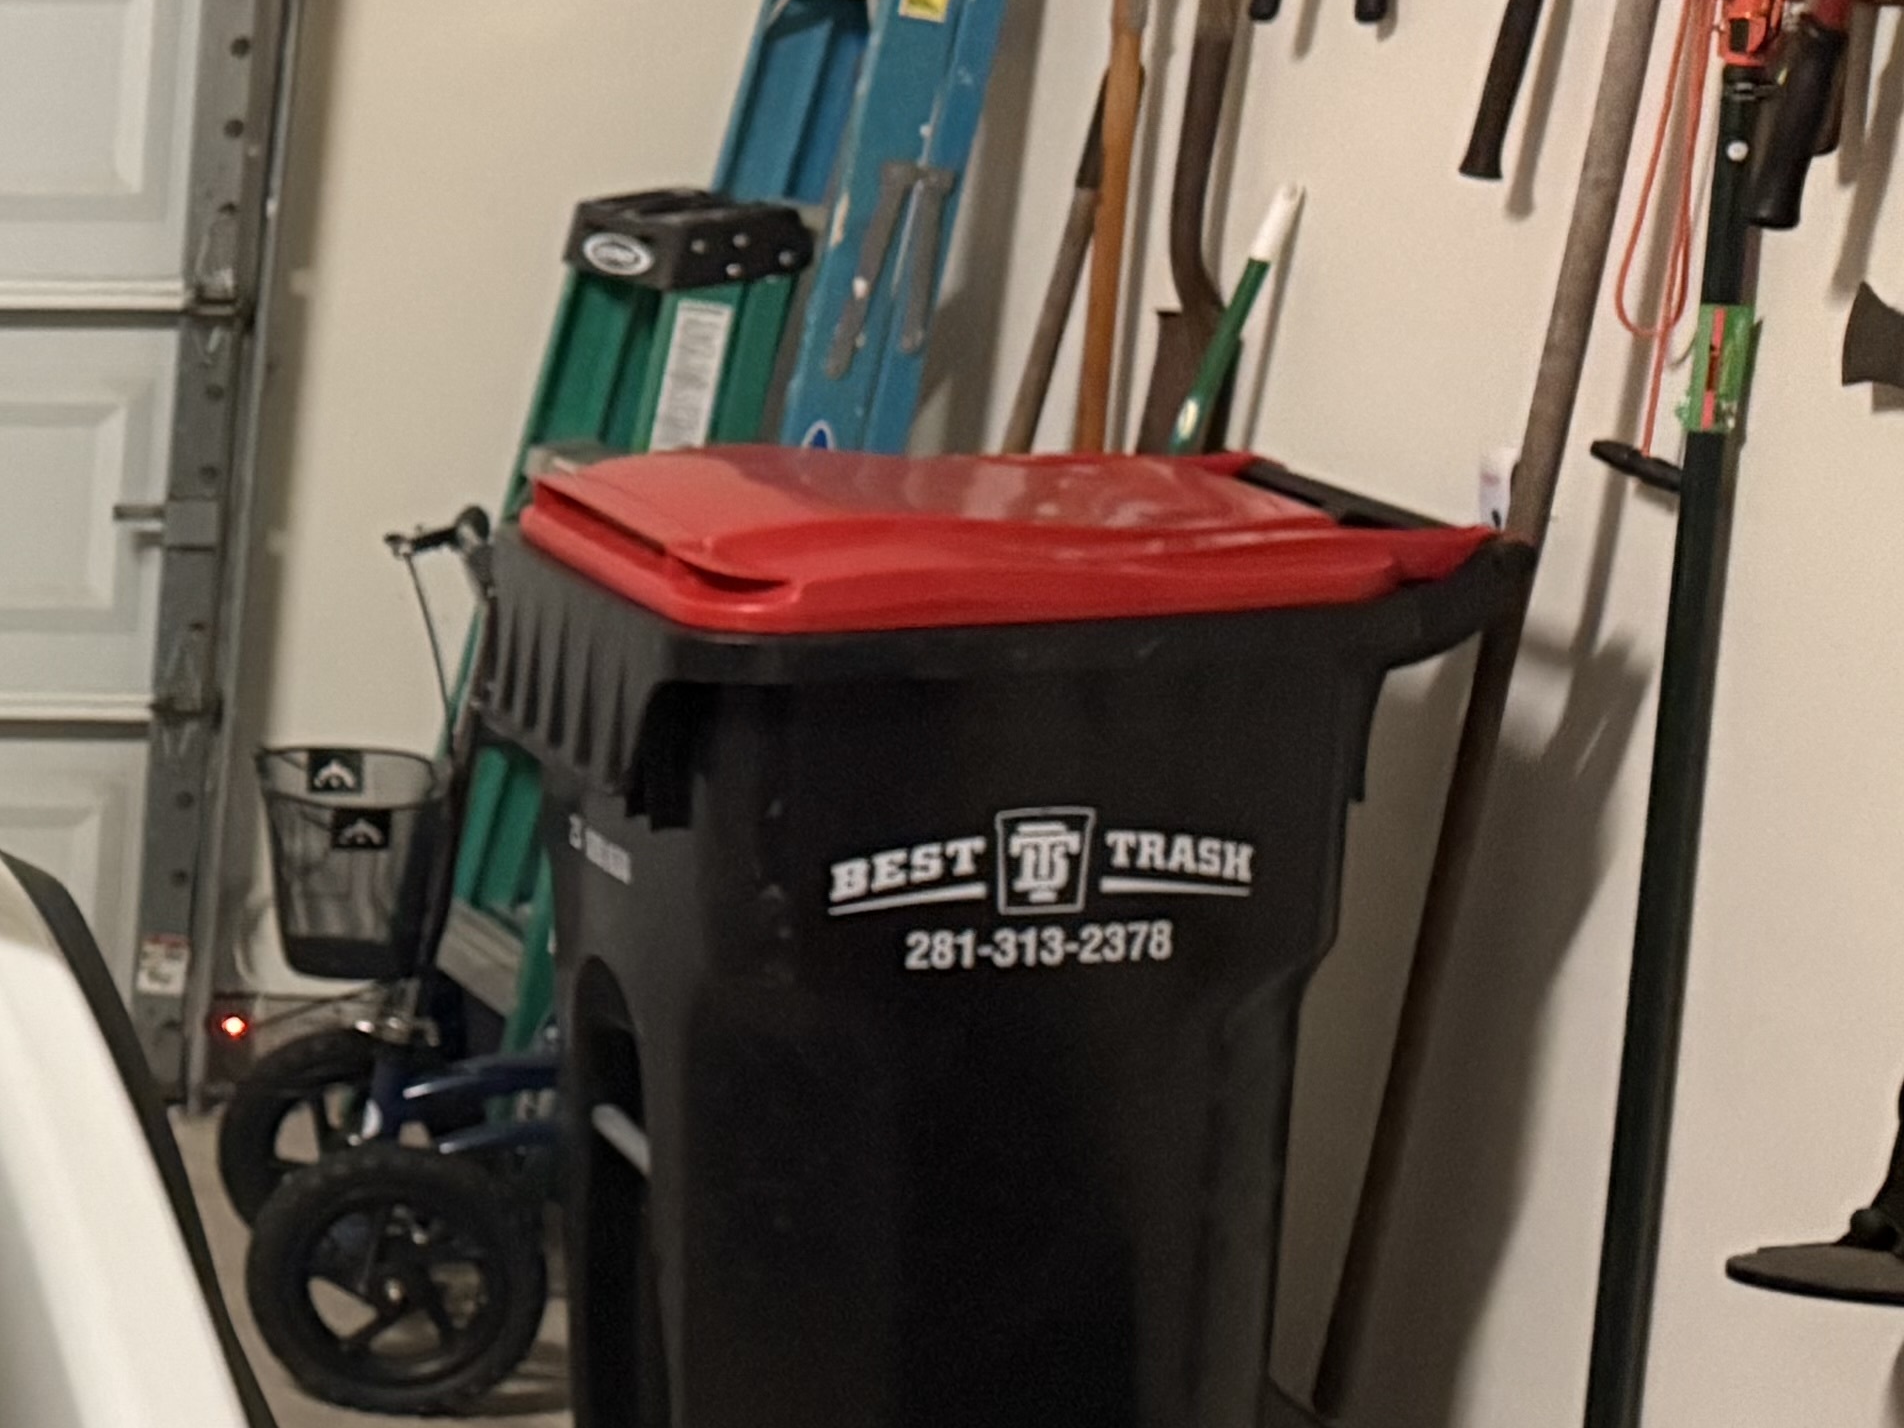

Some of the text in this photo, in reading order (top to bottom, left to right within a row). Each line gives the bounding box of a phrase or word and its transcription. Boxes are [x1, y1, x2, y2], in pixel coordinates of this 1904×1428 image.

[829, 835, 987, 903] BEST
[1104, 829, 1254, 884] TRASH
[904, 918, 1174, 971] 281-313-2378
